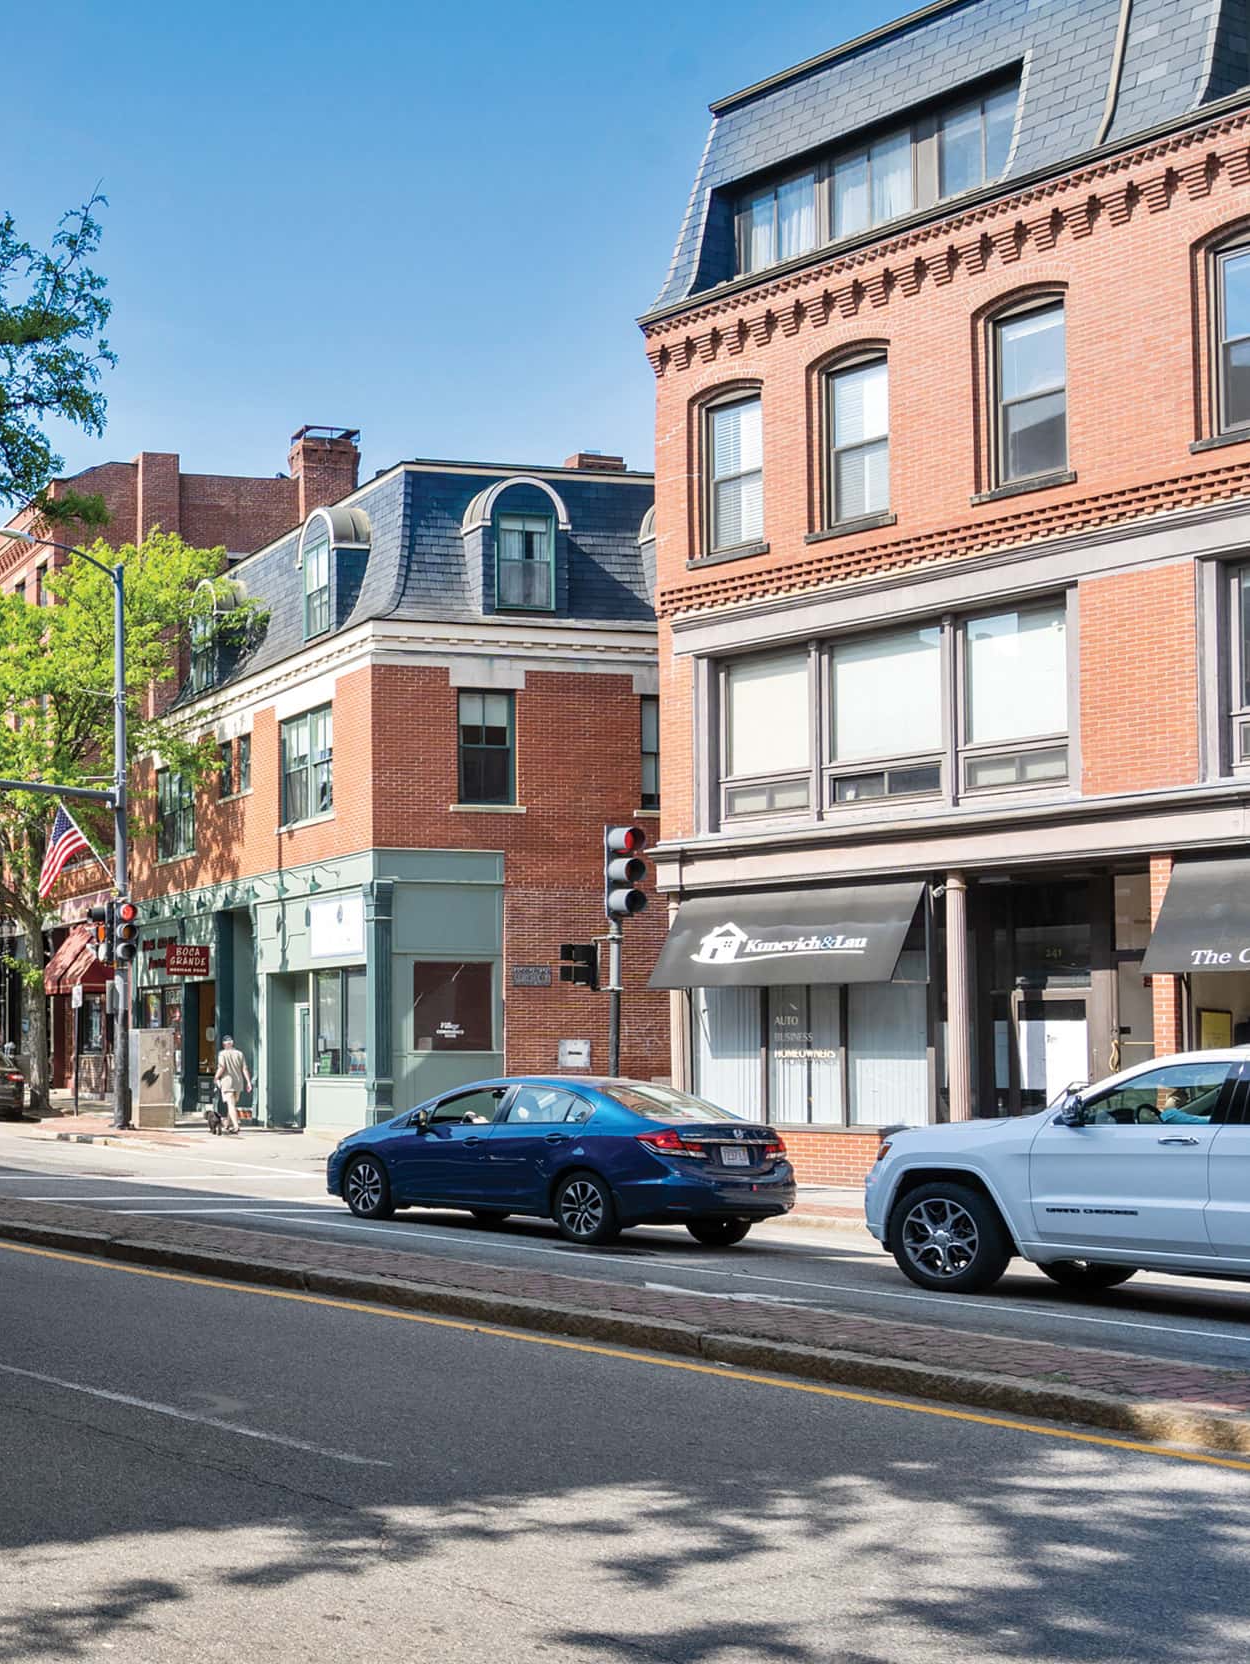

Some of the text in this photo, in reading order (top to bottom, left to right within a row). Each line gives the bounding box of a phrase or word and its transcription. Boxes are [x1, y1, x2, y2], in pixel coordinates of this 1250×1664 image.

[175, 947, 201, 957] BOCA
[170, 957, 207, 966] GRANDE
[1190, 950, 1232, 965] The
[774, 1015, 799, 1026] AUTO
[774, 1032, 814, 1042] BUSINESS
